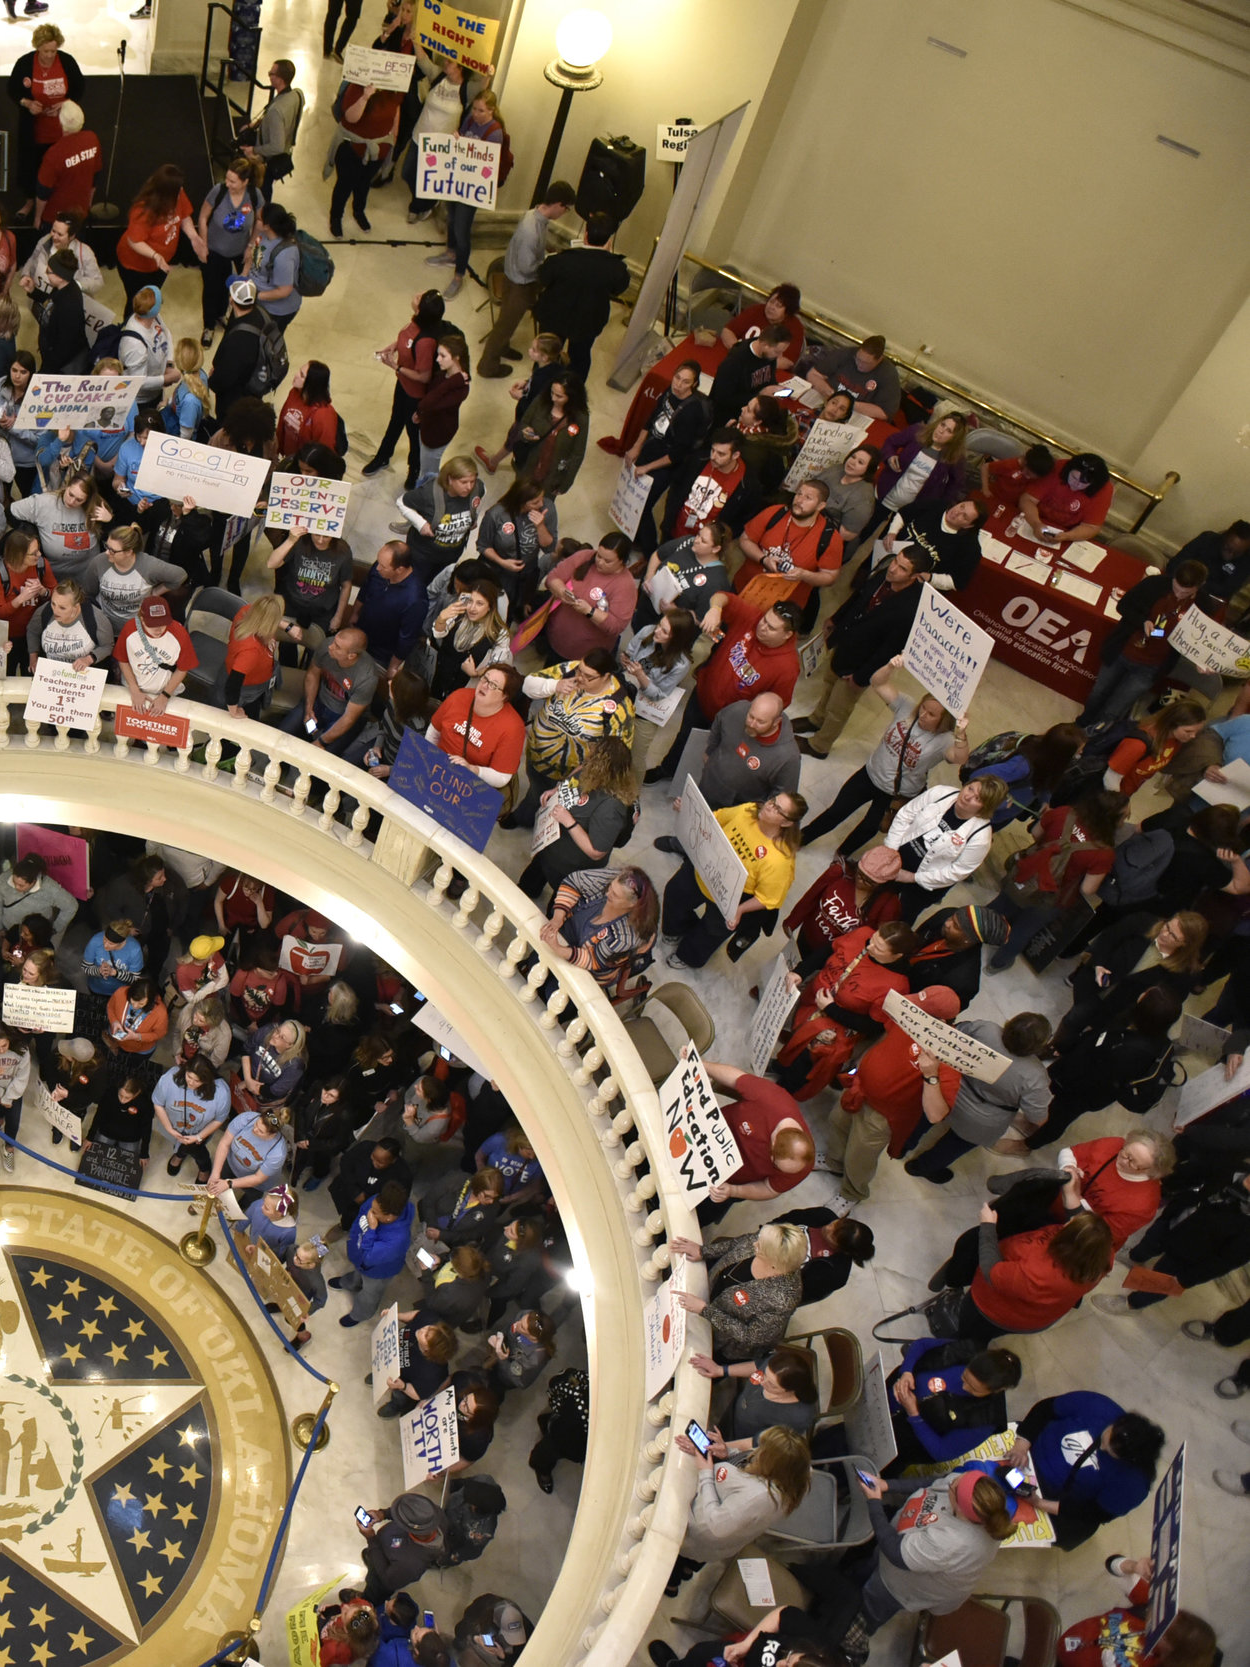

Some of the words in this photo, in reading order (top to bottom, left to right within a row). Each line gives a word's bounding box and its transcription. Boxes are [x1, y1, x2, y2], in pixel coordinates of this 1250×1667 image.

[424, 0, 441, 15] DO
[457, 16, 486, 35] THE
[432, 22, 475, 49] RIGHT
[420, 33, 458, 59] THING
[461, 55, 490, 75] NOW
[385, 61, 413, 74] BEST
[667, 127, 698, 137] Tulsa
[422, 137, 450, 154] Fund
[454, 142, 465, 154] the
[466, 142, 494, 162] Minds
[662, 138, 688, 152] Regi
[65, 154, 81, 168] OEA
[445, 156, 457, 170] of
[460, 163, 478, 173] our
[423, 170, 493, 204] Future!
[42, 381, 70, 393] The
[77, 380, 109, 393] Real
[44, 392, 115, 404] CUPCAKE
[28, 404, 89, 413] OKLAHOMA
[814, 422, 854, 445] Funding
[160, 438, 246, 472] Google
[803, 446, 842, 457] education
[166, 469, 174, 477] no
[176, 472, 200, 483] results
[201, 478, 220, 488] found
[290, 475, 332, 489] OUR
[272, 485, 346, 504] STUDENTS
[695, 484, 715, 496] TOP
[269, 496, 345, 518] DESERVE
[270, 511, 340, 532] BETTER
[930, 594, 972, 646] We're
[1001, 595, 1092, 665] OEA
[1187, 607, 1208, 641] Hug
[1211, 631, 1220, 640] a
[909, 646, 923, 665] Now
[923, 648, 936, 663] the
[973, 609, 1013, 639] Oklahoma
[1012, 630, 1053, 660] Education
[1052, 653, 1099, 682] Association
[985, 626, 1013, 644] putting
[1013, 641, 1051, 666] education
[39, 675, 77, 689] Teachers
[79, 682, 96, 692] put
[52, 668, 88, 682] gofundme
[47, 685, 86, 698] students
[56, 696, 75, 707] 1st
[31, 700, 47, 712] You
[50, 705, 64, 714] put
[70, 709, 93, 719] them
[48, 713, 75, 725] 50th
[126, 716, 178, 733] TOGETHER
[431, 764, 473, 797] FUND
[430, 781, 461, 806] OUR
[900, 1011, 921, 1027] for
[900, 999, 928, 1020] 50th
[931, 1020, 944, 1031] is
[949, 1030, 975, 1048] not
[978, 1046, 999, 1060] ok
[900, 1020, 922, 1039] but
[924, 1039, 934, 1049] it
[937, 1046, 950, 1057] is
[955, 1056, 978, 1070] for
[687, 1049, 712, 1110] Fund
[705, 1106, 735, 1167] Public
[681, 1069, 721, 1186] Education
[106, 1147, 117, 1160] 12
[0, 1202, 153, 1276] STATE
[149, 1263, 222, 1326] OF
[735, 1291, 747, 1305] OEA
[423, 1397, 443, 1473] WORTH
[447, 1410, 458, 1458] Students
[183, 1320, 268, 1637] OKLAHOMA
